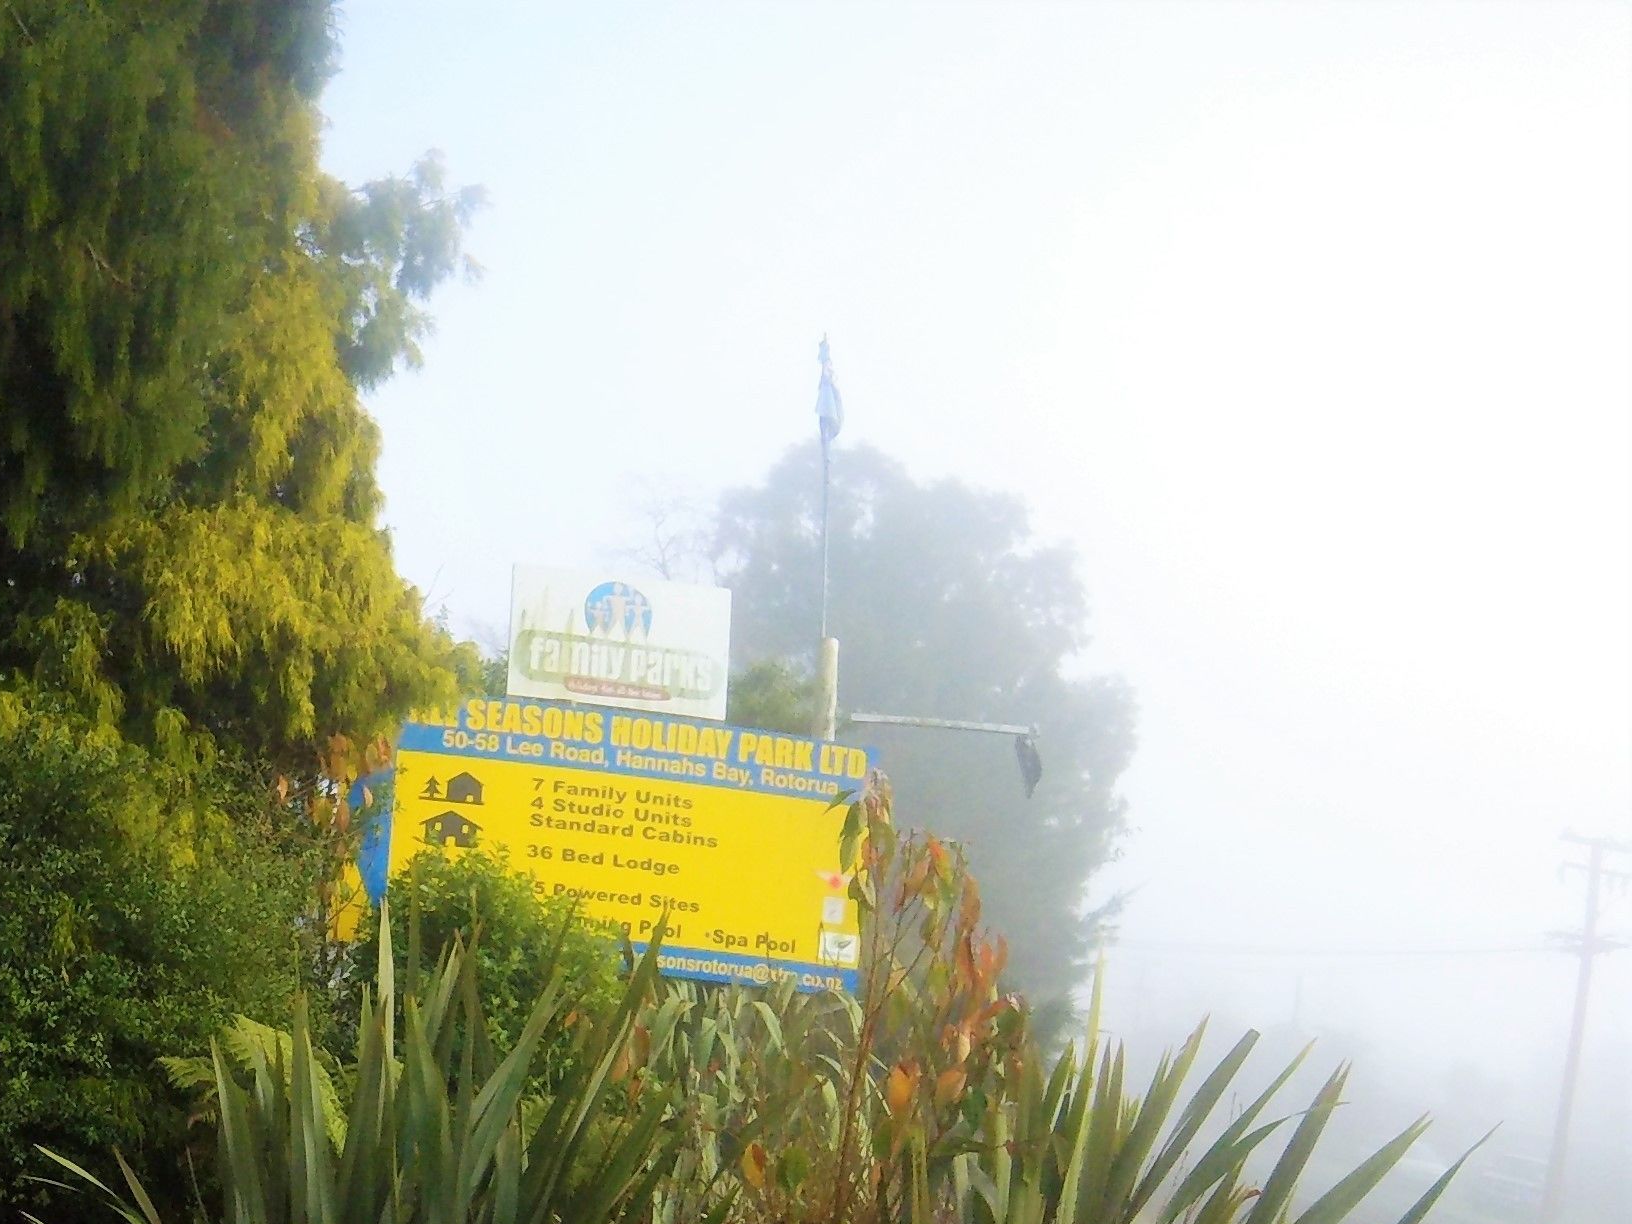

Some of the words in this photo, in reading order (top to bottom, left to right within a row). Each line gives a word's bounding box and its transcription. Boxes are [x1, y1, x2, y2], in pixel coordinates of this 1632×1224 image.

[630, 648, 713, 694] parks
[466, 699, 604, 745] SEASONS
[610, 715, 733, 760] HOLIDAY
[739, 732, 815, 772] PARK
[819, 744, 868, 780] LTD
[442, 729, 500, 753] 50-58
[506, 736, 544, 757] Lee
[550, 741, 610, 767] Road,
[616, 749, 707, 778] Hannahs
[761, 768, 839, 796] Rotorua
[532, 777, 546, 793] 7
[553, 780, 628, 805] Family
[635, 789, 694, 811] Units
[530, 796, 545, 810] 4
[553, 798, 625, 820] Studio
[634, 807, 693, 828] Units
[529, 813, 635, 839] Standard
[642, 826, 720, 849] Cabins
[526, 844, 555, 861] 36
[562, 847, 605, 866] Bed
[613, 854, 681, 877] Lodge
[553, 882, 642, 907] Powered
[649, 894, 701, 914] Sites
[712, 929, 748, 948] Spa
[755, 932, 796, 954] Pool
